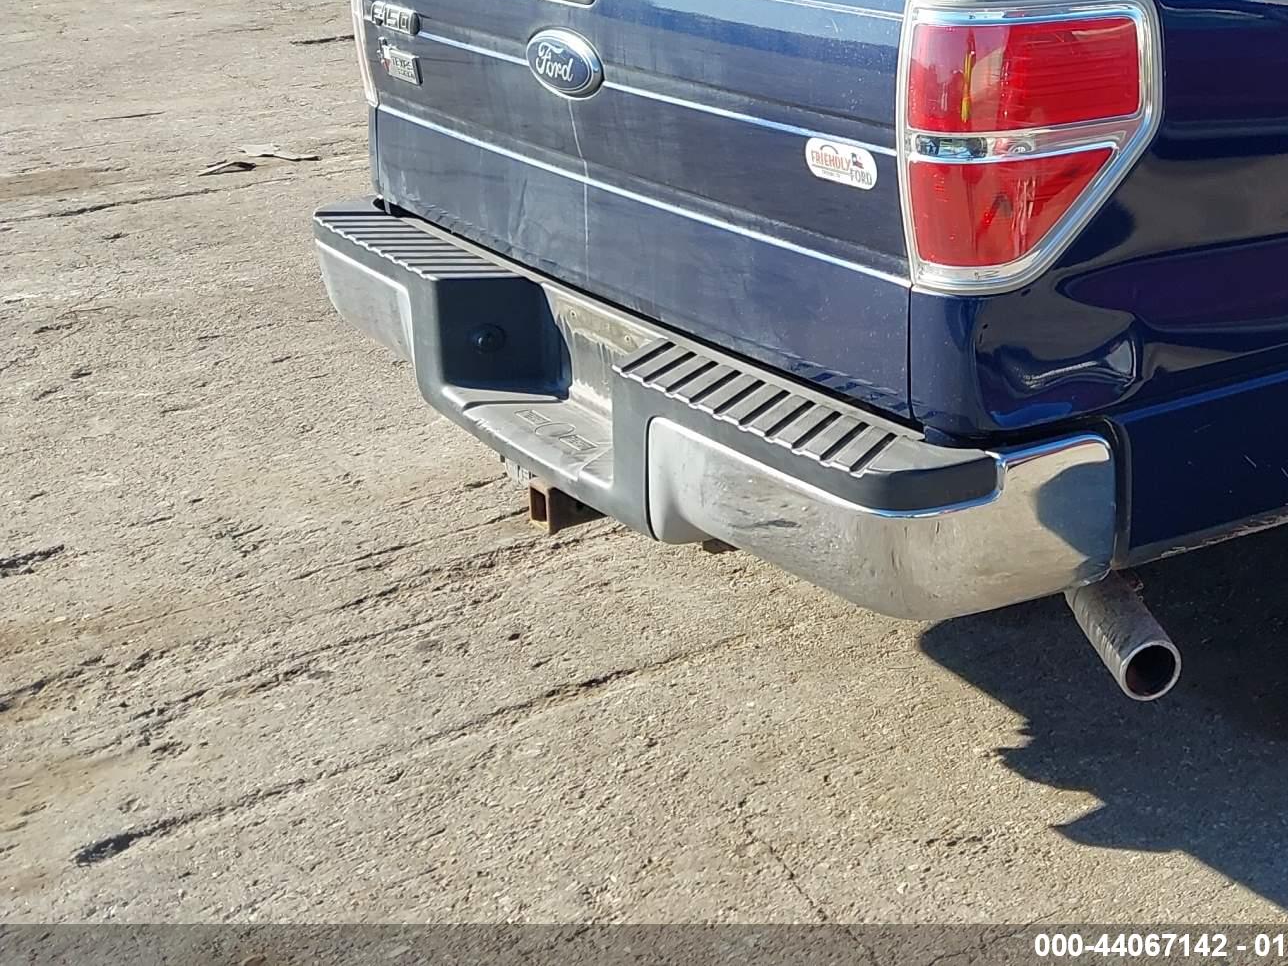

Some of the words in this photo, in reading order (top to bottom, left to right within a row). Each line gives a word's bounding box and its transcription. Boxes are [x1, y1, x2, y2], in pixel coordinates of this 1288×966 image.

[535, 41, 575, 82] Ford
[811, 150, 851, 171] FRIENDLY
[850, 168, 873, 185] FORD
